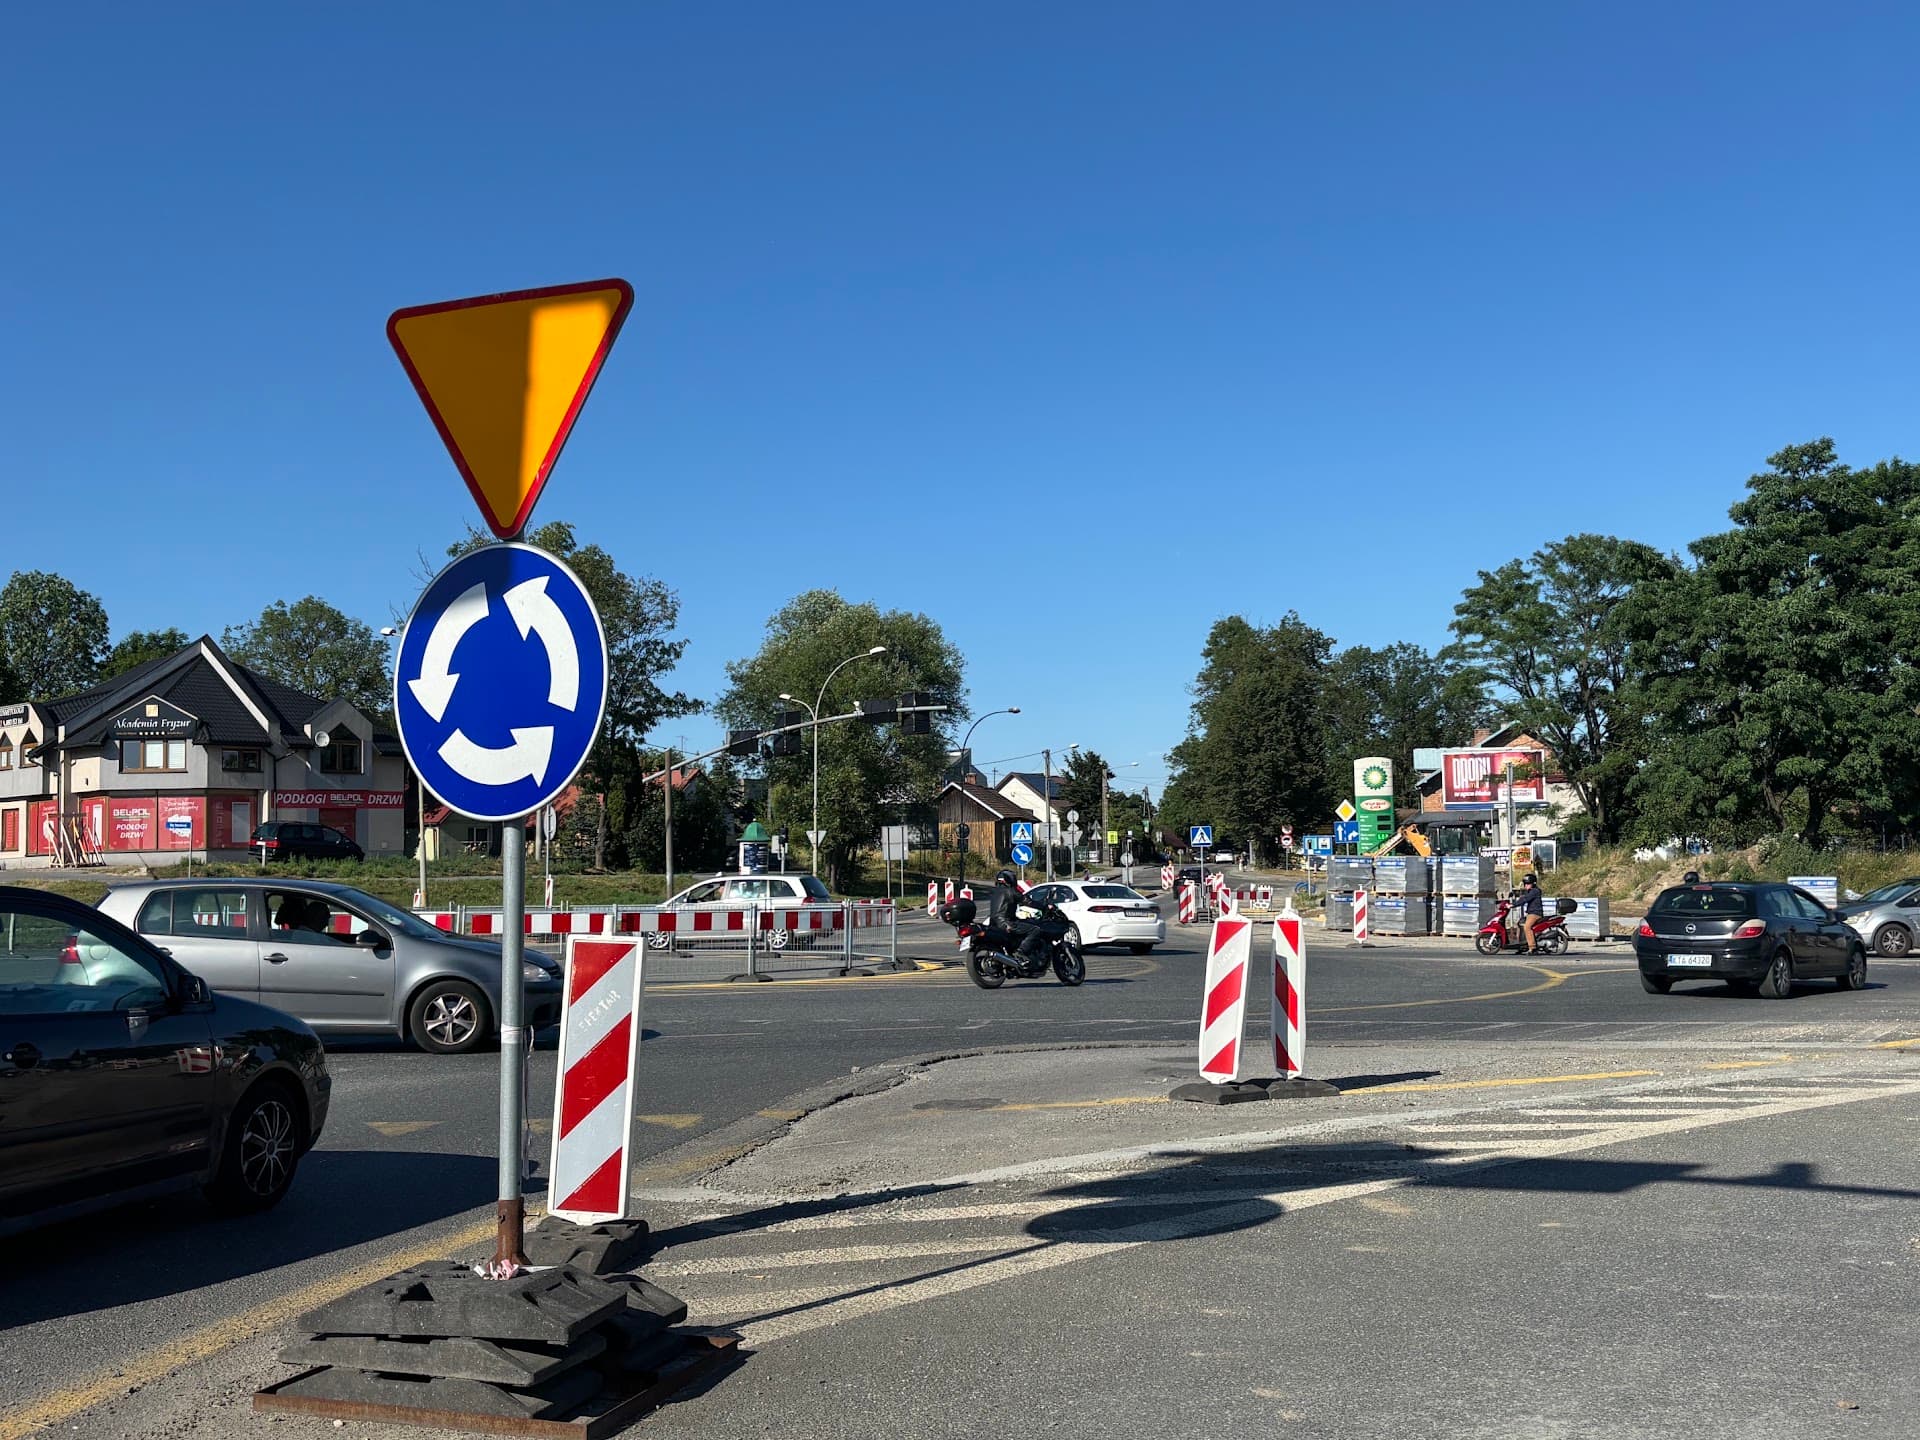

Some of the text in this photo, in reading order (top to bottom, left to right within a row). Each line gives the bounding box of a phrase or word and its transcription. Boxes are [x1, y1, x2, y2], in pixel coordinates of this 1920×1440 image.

[114, 718, 191, 731] Akademia Fryzur
[276, 793, 327, 804] PODŁOGI
[368, 794, 403, 804] DRZWI
[120, 831, 144, 839] DRZWI
